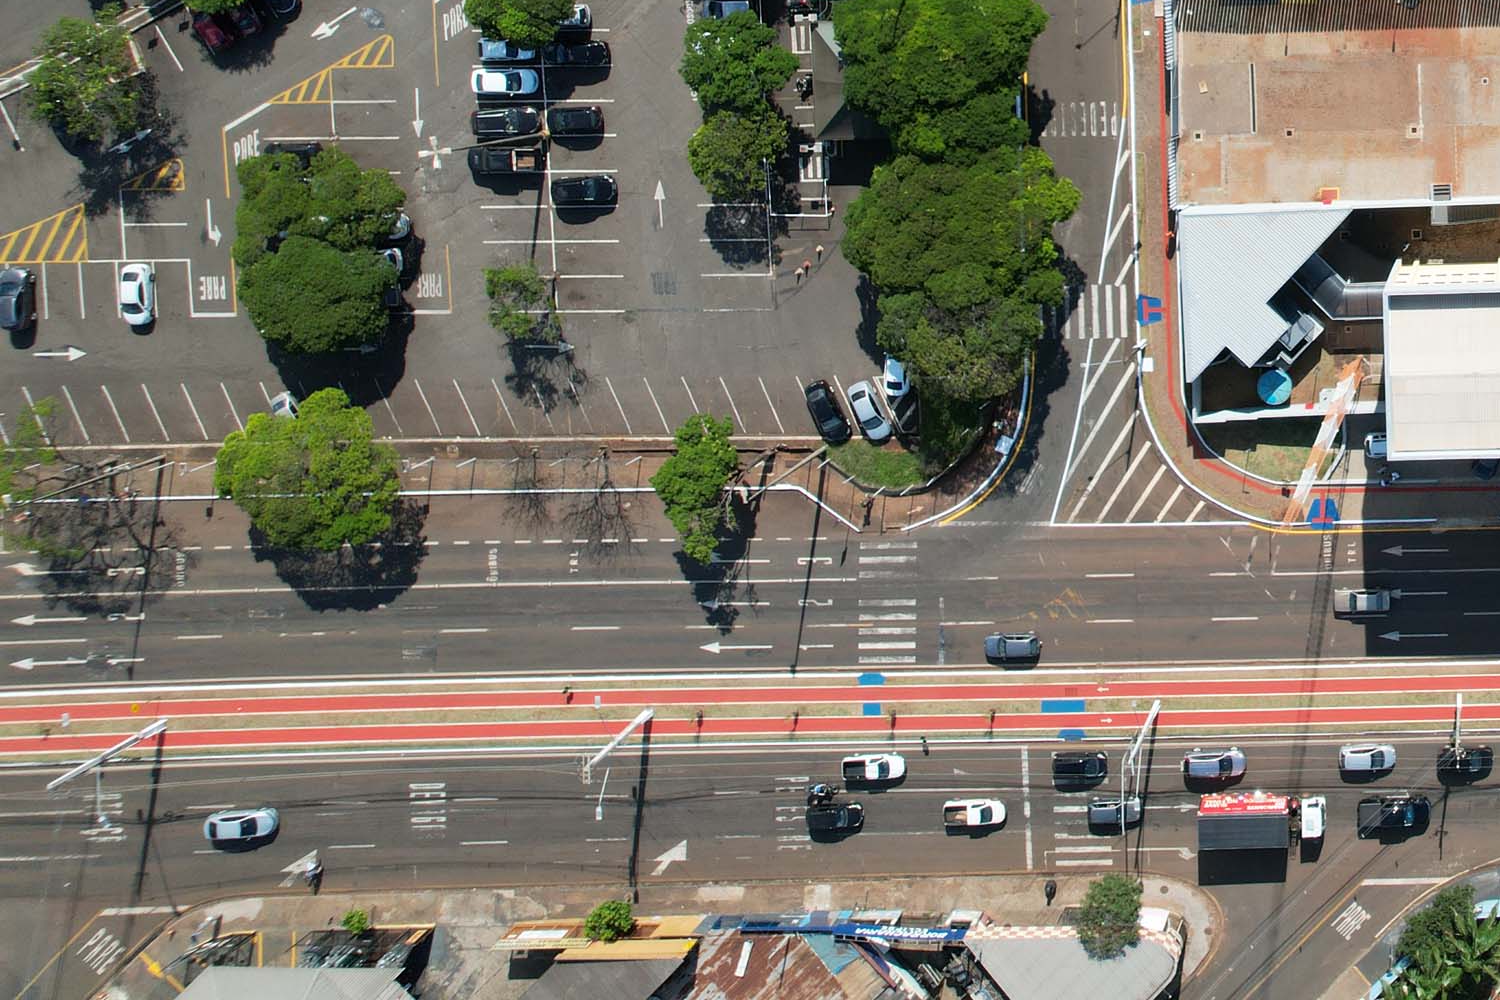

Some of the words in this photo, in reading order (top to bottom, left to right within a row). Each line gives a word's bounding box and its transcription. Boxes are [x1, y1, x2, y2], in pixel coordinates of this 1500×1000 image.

[233, 128, 260, 166] PARE
[199, 275, 226, 300] PARE
[569, 551, 580, 573] TRL
[1332, 901, 1372, 942] PARE
[76, 927, 127, 977] PARE
